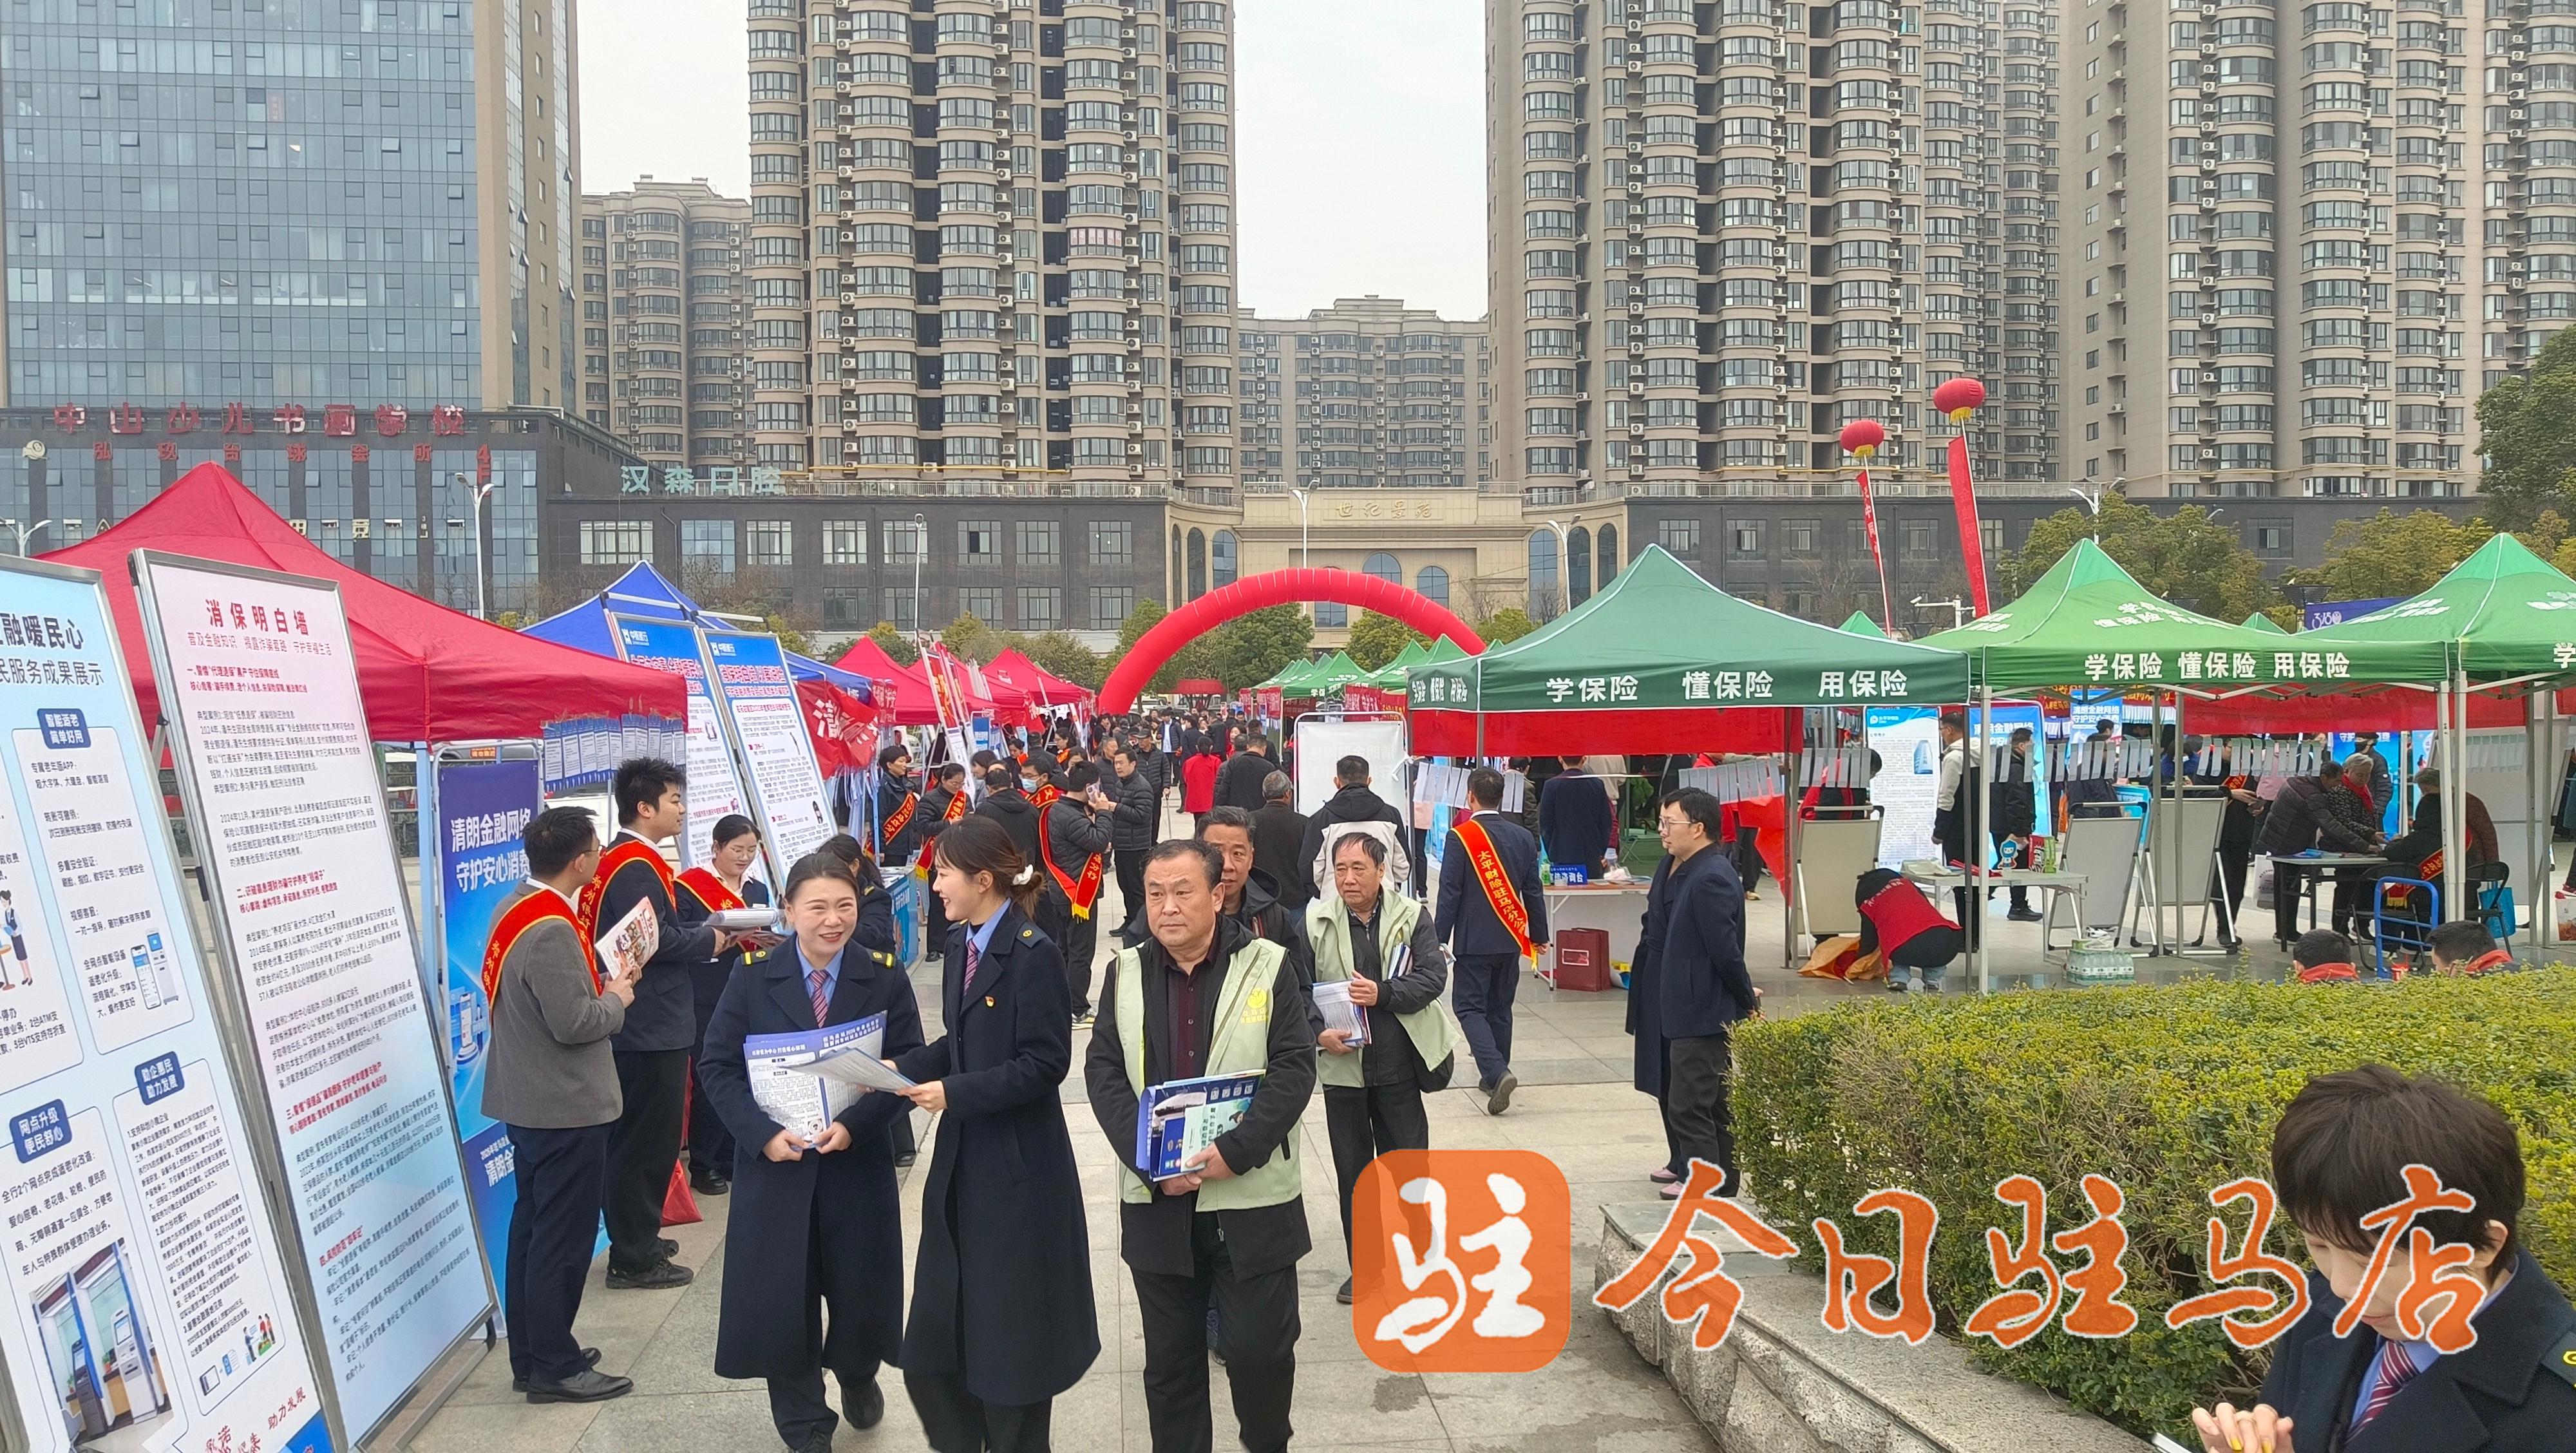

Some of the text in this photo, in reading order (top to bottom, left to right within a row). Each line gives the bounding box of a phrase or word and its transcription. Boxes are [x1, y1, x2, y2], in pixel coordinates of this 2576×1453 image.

[54, 401, 466, 437] 中山少儿书画学校
[620, 465, 786, 495] 汉森口腔
[0, 613, 84, 651] 融暖民心
[204, 599, 310, 636] 消保明白墙
[2084, 651, 2351, 681] 学保险 懂保险 用保险
[1546, 669, 1909, 704] 学保险 懂保险 用保险
[451, 808, 531, 853] 清朗金融网络
[456, 848, 533, 893] 守护安心消费
[484, 1145, 515, 1188] 清朗金
